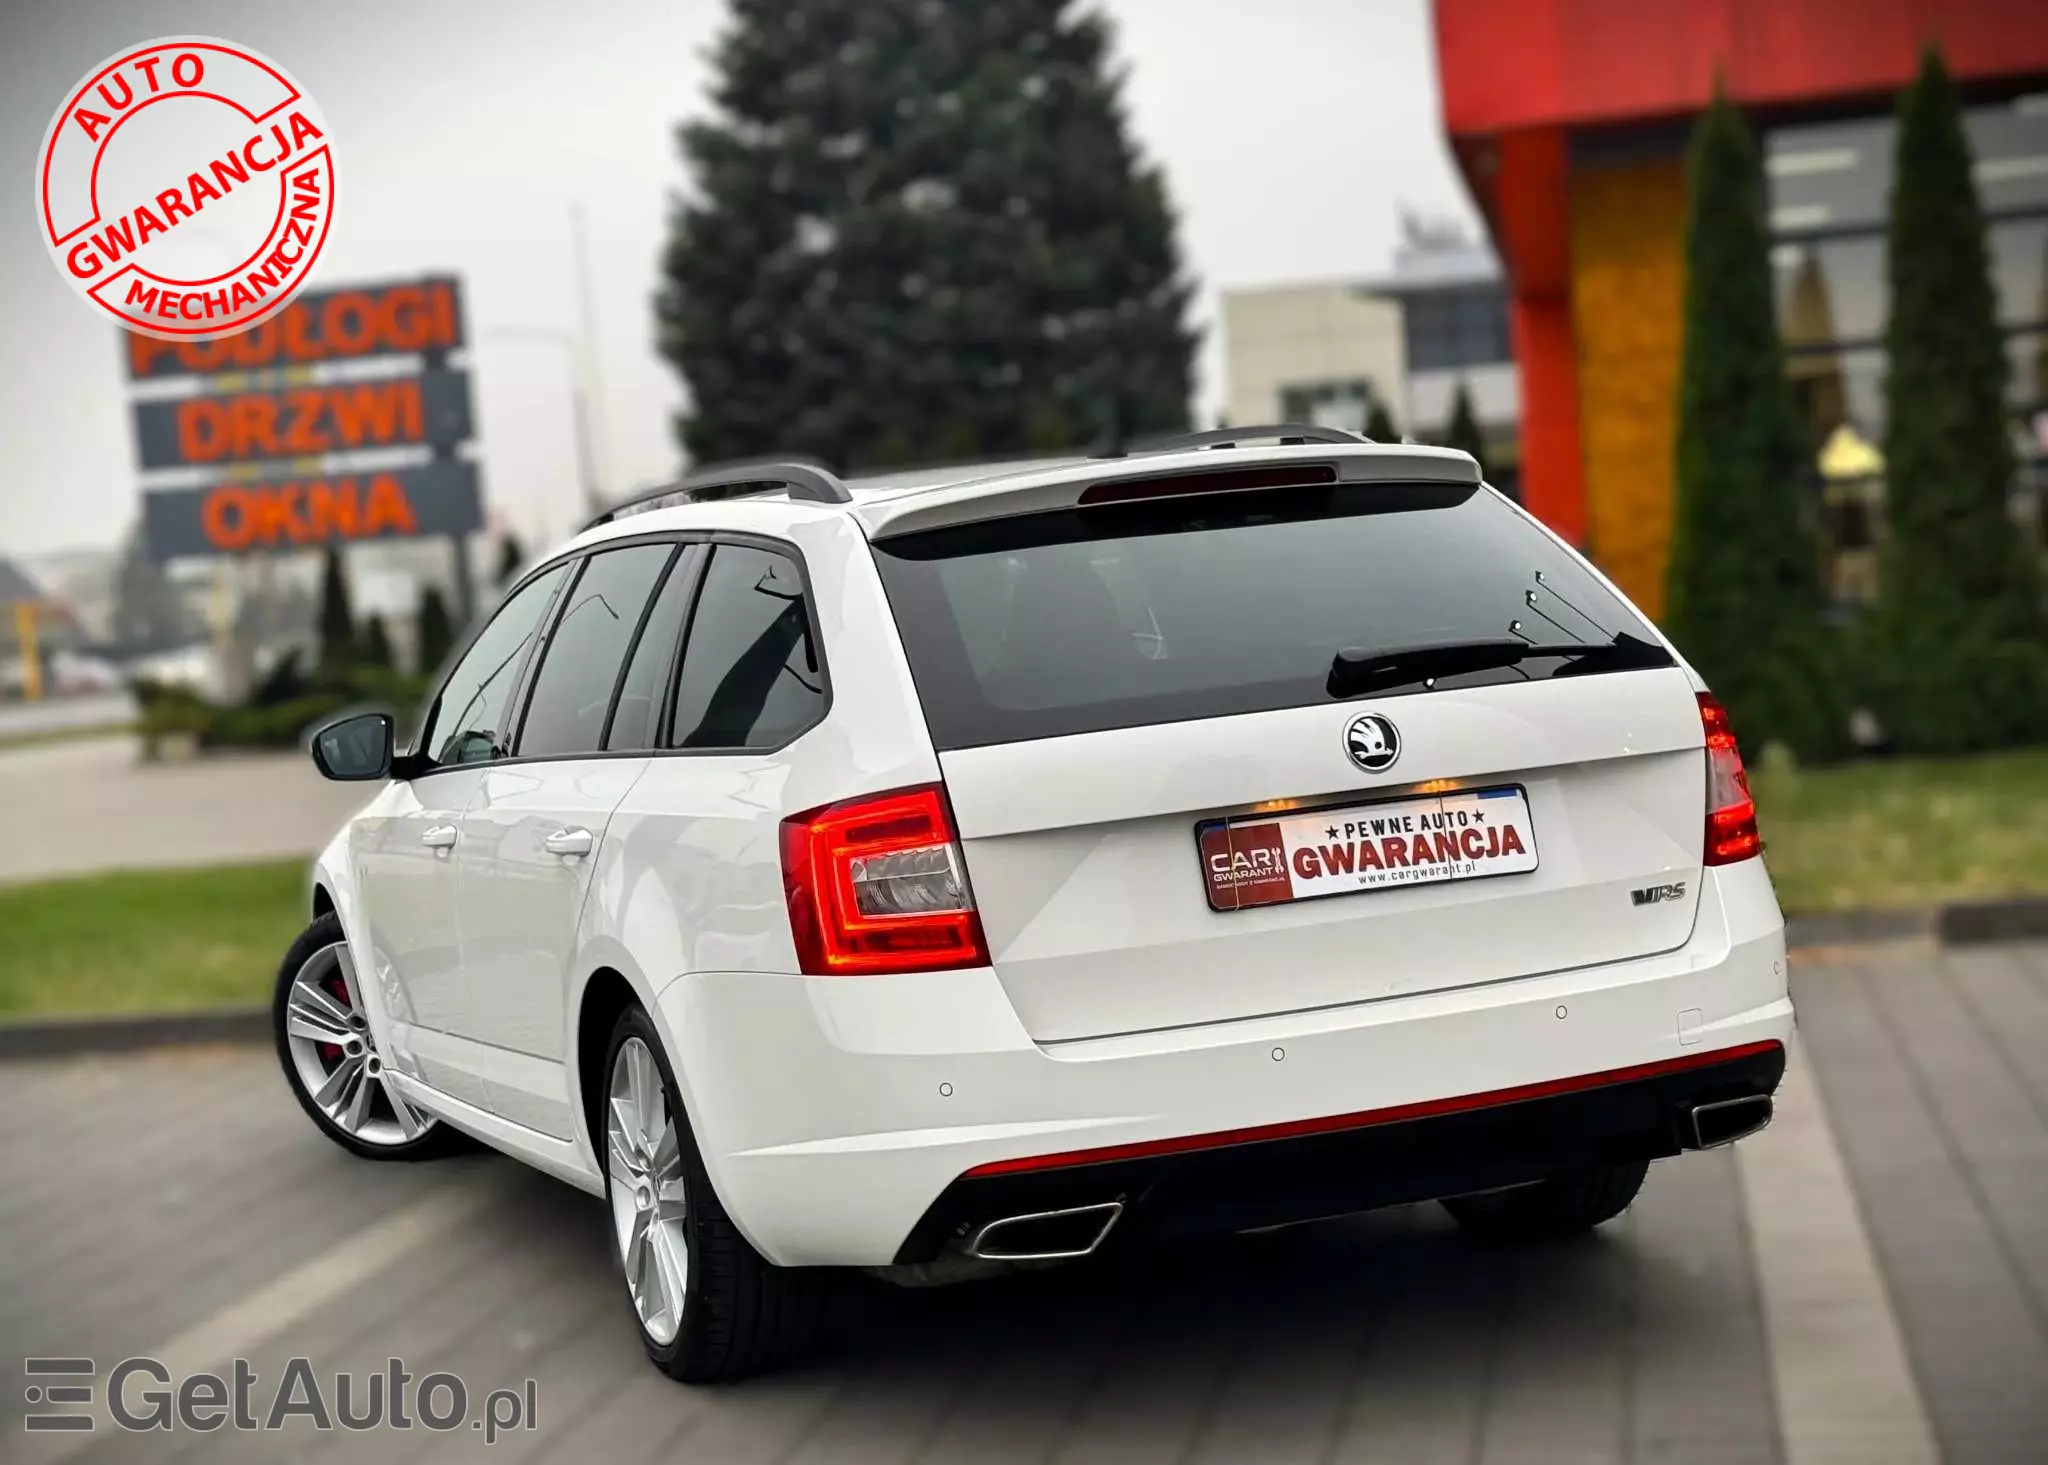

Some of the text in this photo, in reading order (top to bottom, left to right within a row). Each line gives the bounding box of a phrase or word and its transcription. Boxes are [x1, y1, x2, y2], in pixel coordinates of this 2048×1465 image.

[176, 382, 422, 463] DRZWI
[203, 477, 416, 549] OKNA
[1345, 809, 1468, 840] PEWNE AUTO
[1210, 848, 1272, 873] CAR
[1292, 824, 1526, 880] GWARANCJA
[1213, 866, 1273, 882] GWARANT
[1357, 860, 1477, 885] www.cargwarant.pl
